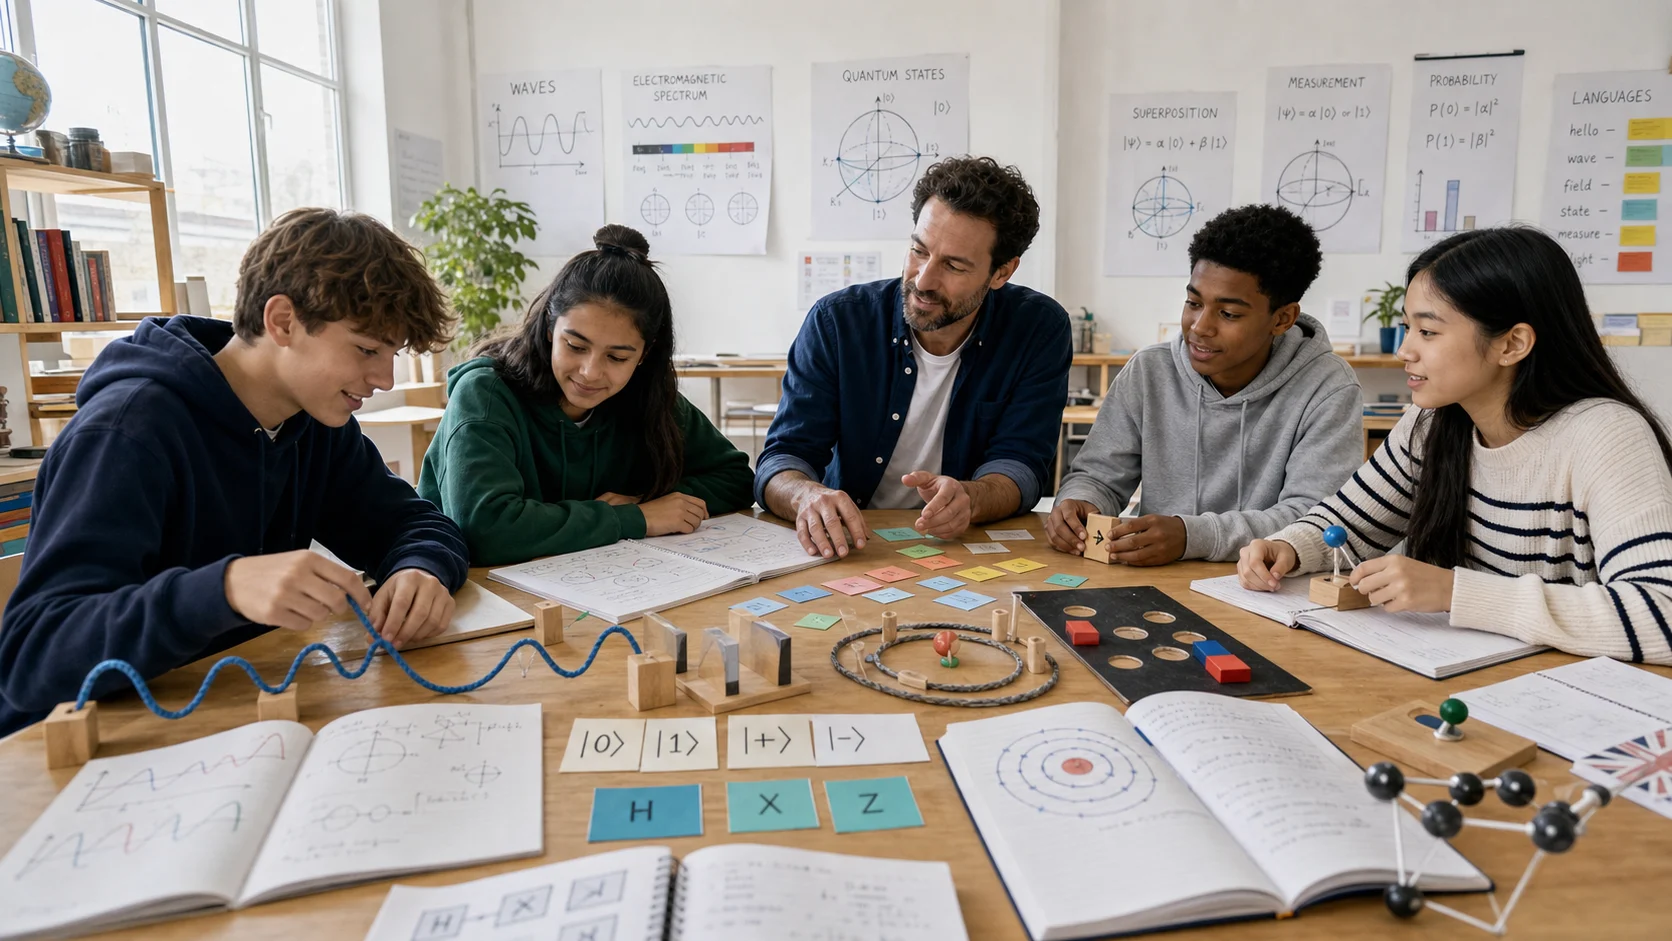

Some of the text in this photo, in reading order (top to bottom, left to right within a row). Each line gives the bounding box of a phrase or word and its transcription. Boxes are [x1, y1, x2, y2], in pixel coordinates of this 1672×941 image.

[633, 74, 727, 86] ELECTROMAGNETIC
[843, 68, 945, 83] QUANTUM STATES
[1430, 74, 1497, 87] PROBABILITY
[510, 80, 556, 95] WAVES
[1288, 77, 1366, 88] MEASUREMENT
[653, 90, 708, 101] SPECTRUM
[1573, 89, 1652, 105] LANGUAGES
[1133, 107, 1218, 119] SUPERPOSITION
[1570, 123, 1599, 136] hello
[1568, 155, 1597, 164] wave
[1564, 178, 1592, 193] field
[1560, 205, 1590, 217] state
[1558, 230, 1600, 239] measure
[759, 793, 783, 815] X
[858, 793, 884, 814] Z
[630, 800, 653, 822] H
